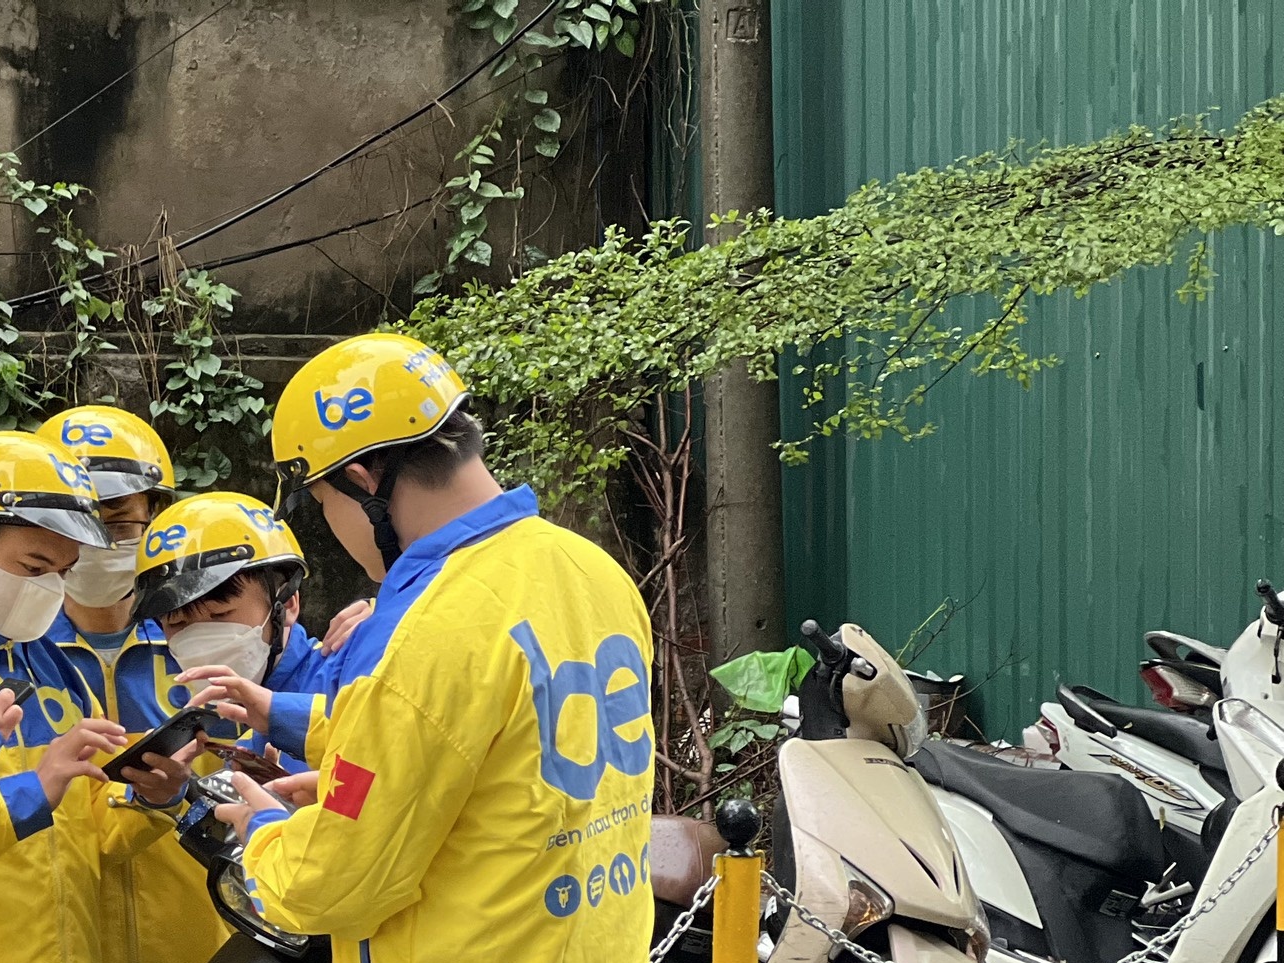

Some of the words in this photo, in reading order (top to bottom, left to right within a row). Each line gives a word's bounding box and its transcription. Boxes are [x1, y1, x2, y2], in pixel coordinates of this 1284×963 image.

[314, 387, 374, 431] be
[61, 419, 113, 447] be
[47, 453, 92, 489] be
[145, 524, 187, 558] be
[508, 618, 653, 802] be
